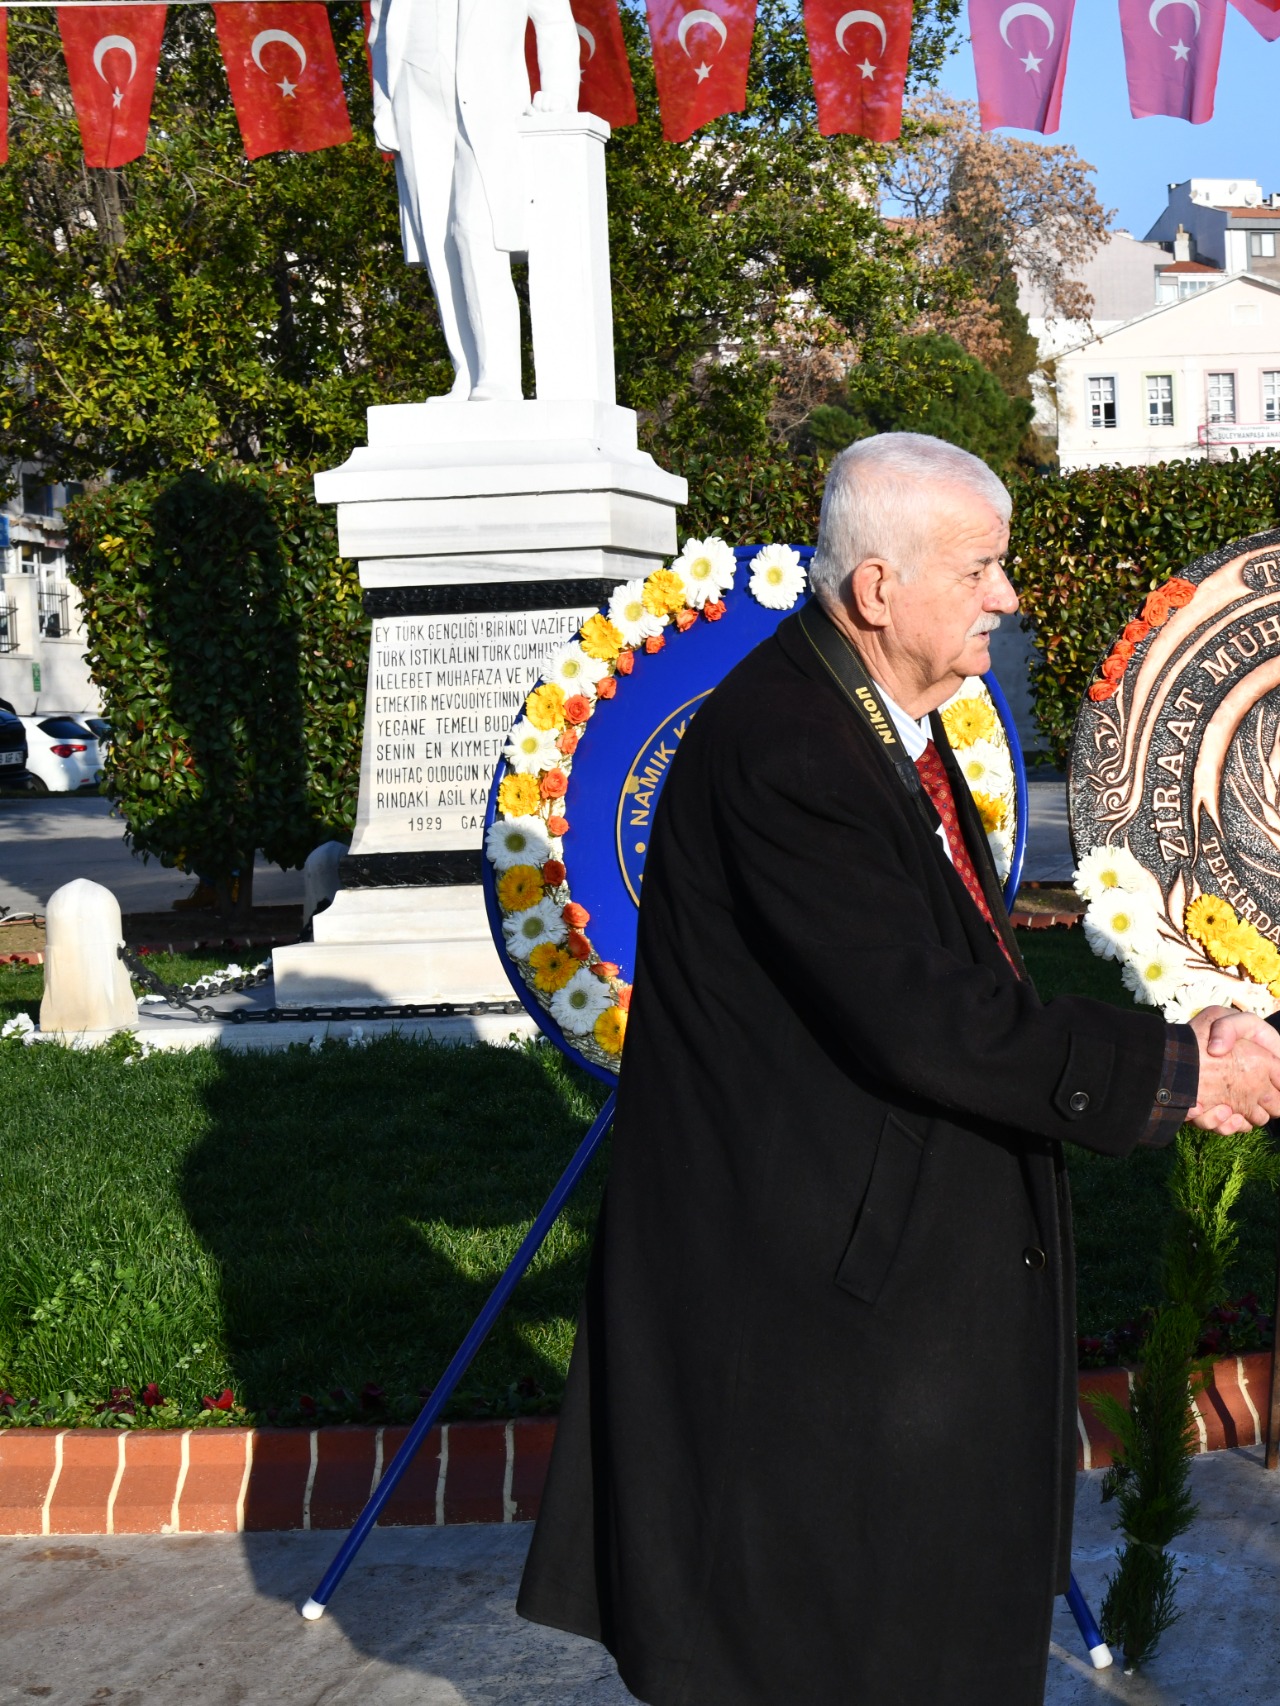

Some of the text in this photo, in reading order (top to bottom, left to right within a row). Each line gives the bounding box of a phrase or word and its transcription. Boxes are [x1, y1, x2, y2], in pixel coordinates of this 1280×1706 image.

[375, 626, 390, 643] EY
[395, 620, 425, 641] TÜRK
[486, 613, 527, 638] BİRİNCİ
[376, 645, 406, 667] TÜRK
[482, 639, 511, 662] TÜRK
[376, 669, 432, 690] İLELEBET
[437, 667, 502, 687] MUHAFAZA
[506, 667, 521, 684] VE
[376, 690, 427, 713] ETMEKTİR
[431, 686, 520, 711] MEVCUDİYETİNİN
[436, 711, 478, 734] TEMELİ
[855, 686, 896, 744] Nikon
[376, 739, 415, 761] SENİN
[425, 741, 442, 759] EN
[427, 762, 479, 783] OLDUĞUN
[630, 740, 677, 826] NAMIK
[1150, 687, 1204, 865] ZİRAAT
[377, 786, 428, 809] RINDAKİ
[438, 785, 466, 807] ASİL
[408, 817, 442, 832] 1929
